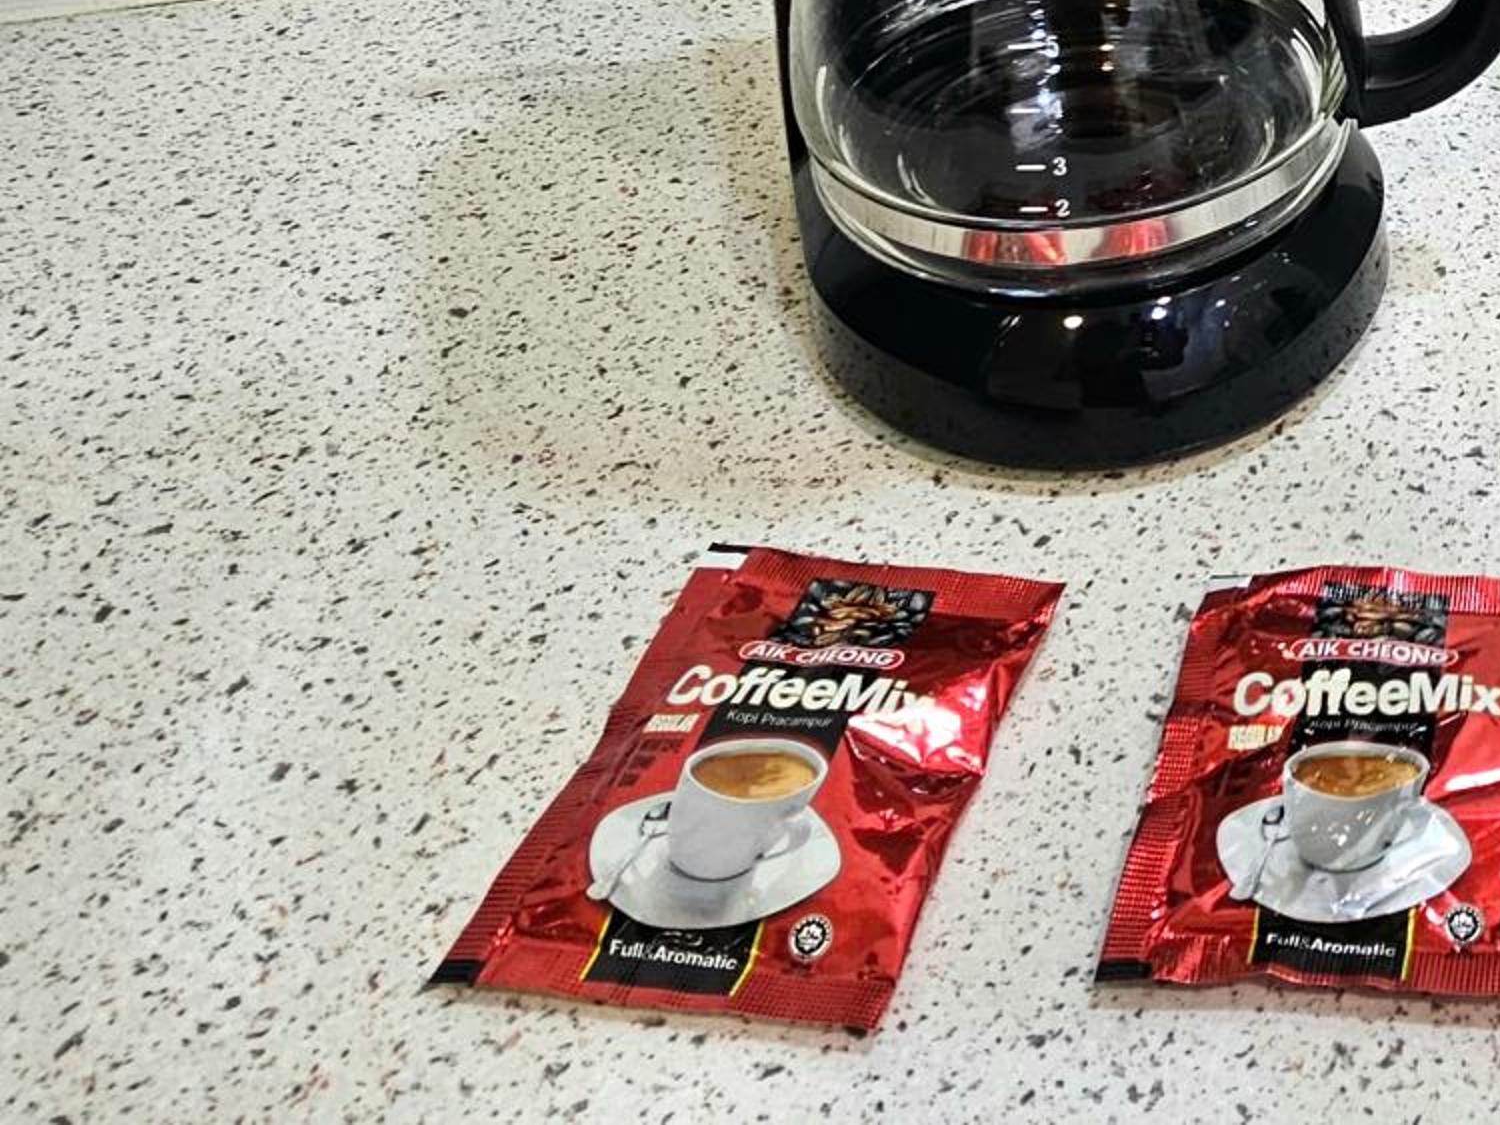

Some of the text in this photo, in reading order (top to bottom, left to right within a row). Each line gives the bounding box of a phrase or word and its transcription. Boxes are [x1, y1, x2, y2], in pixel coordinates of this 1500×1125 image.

[1052, 156, 1068, 176] 3
[1055, 198, 1071, 218] 2
[1299, 642, 1450, 664] AIK CHEONG
[726, 709, 760, 724] Kopi
